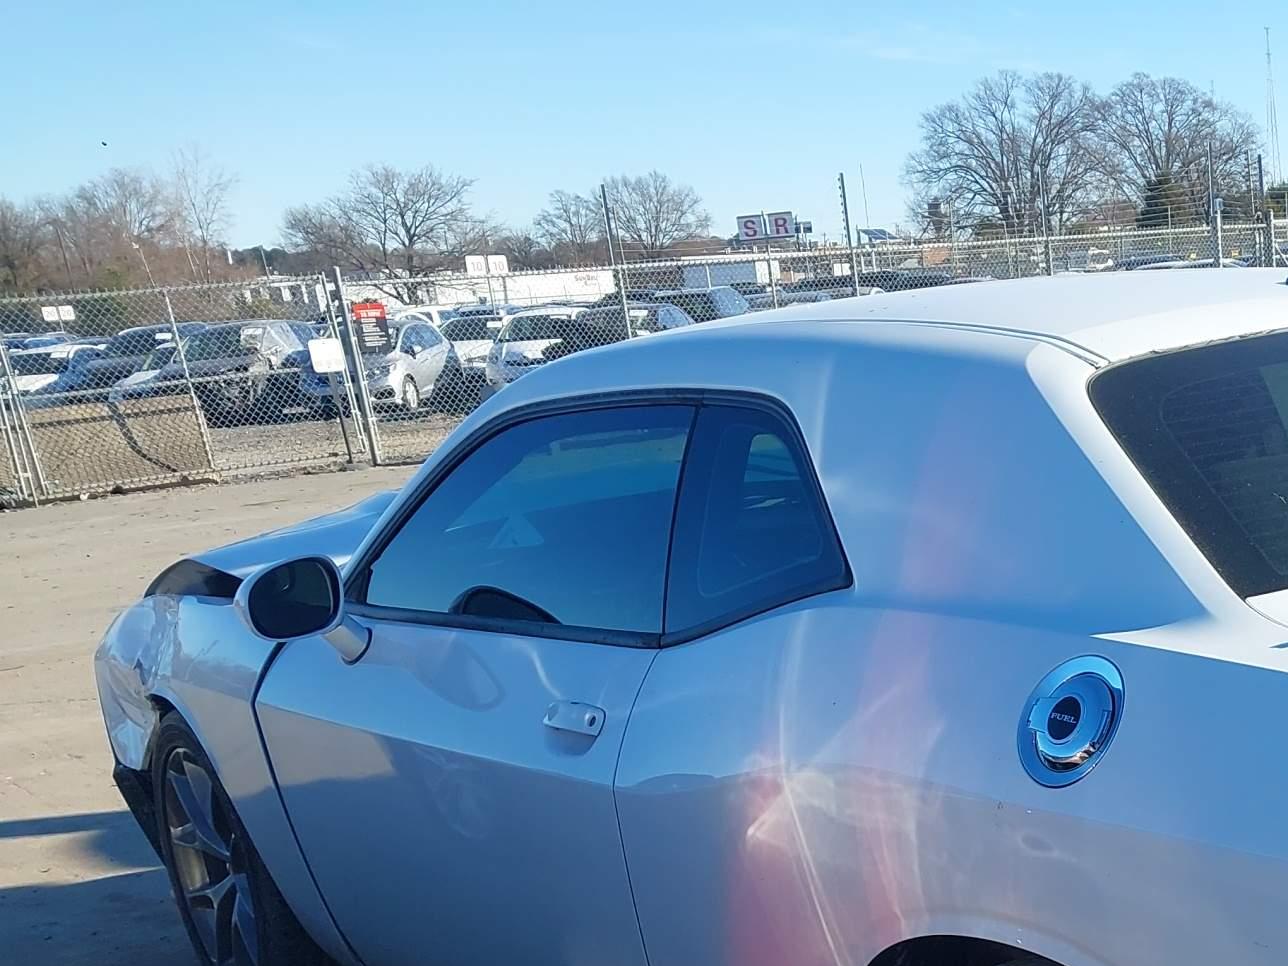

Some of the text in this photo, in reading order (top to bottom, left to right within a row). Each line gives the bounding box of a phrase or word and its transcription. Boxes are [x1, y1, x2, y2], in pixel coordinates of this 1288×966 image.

[471, 261, 483, 272] 10
[493, 261, 505, 272] 10
[1050, 712, 1077, 724] FUEL
